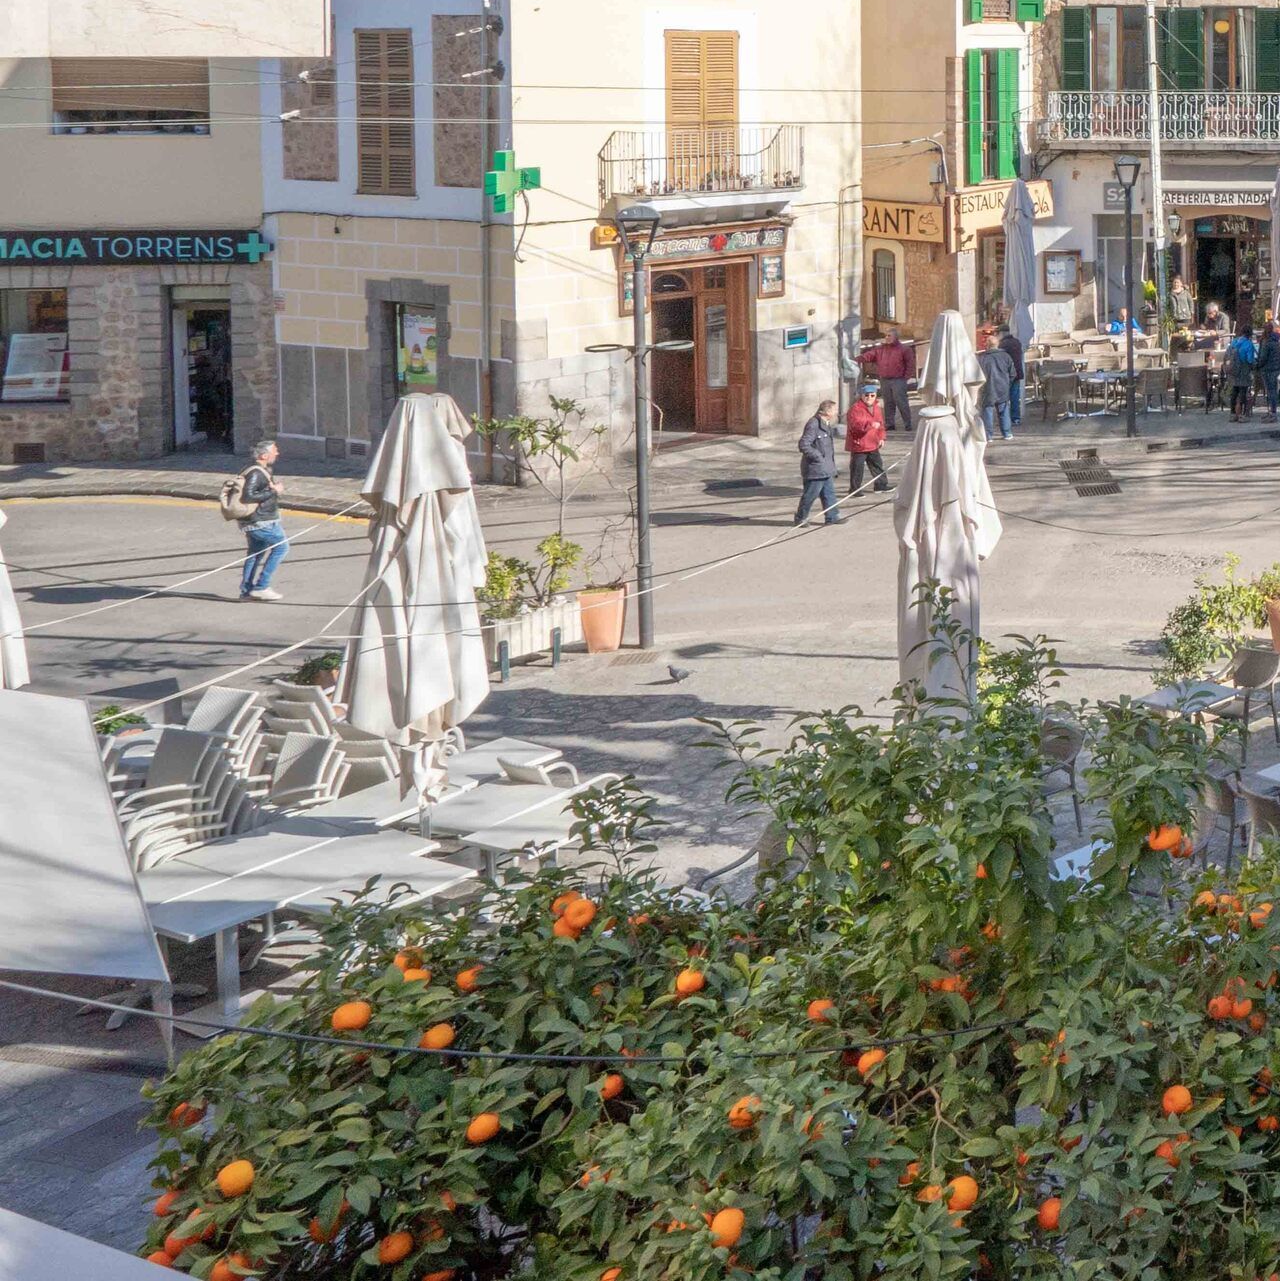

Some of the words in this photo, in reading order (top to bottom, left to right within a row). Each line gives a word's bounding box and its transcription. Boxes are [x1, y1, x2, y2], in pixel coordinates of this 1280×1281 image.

[954, 191, 1005, 215] RESTAUR
[1214, 192, 1235, 204] BAR
[0, 238, 88, 259] ACIA
[92, 237, 234, 258] TORRENS
